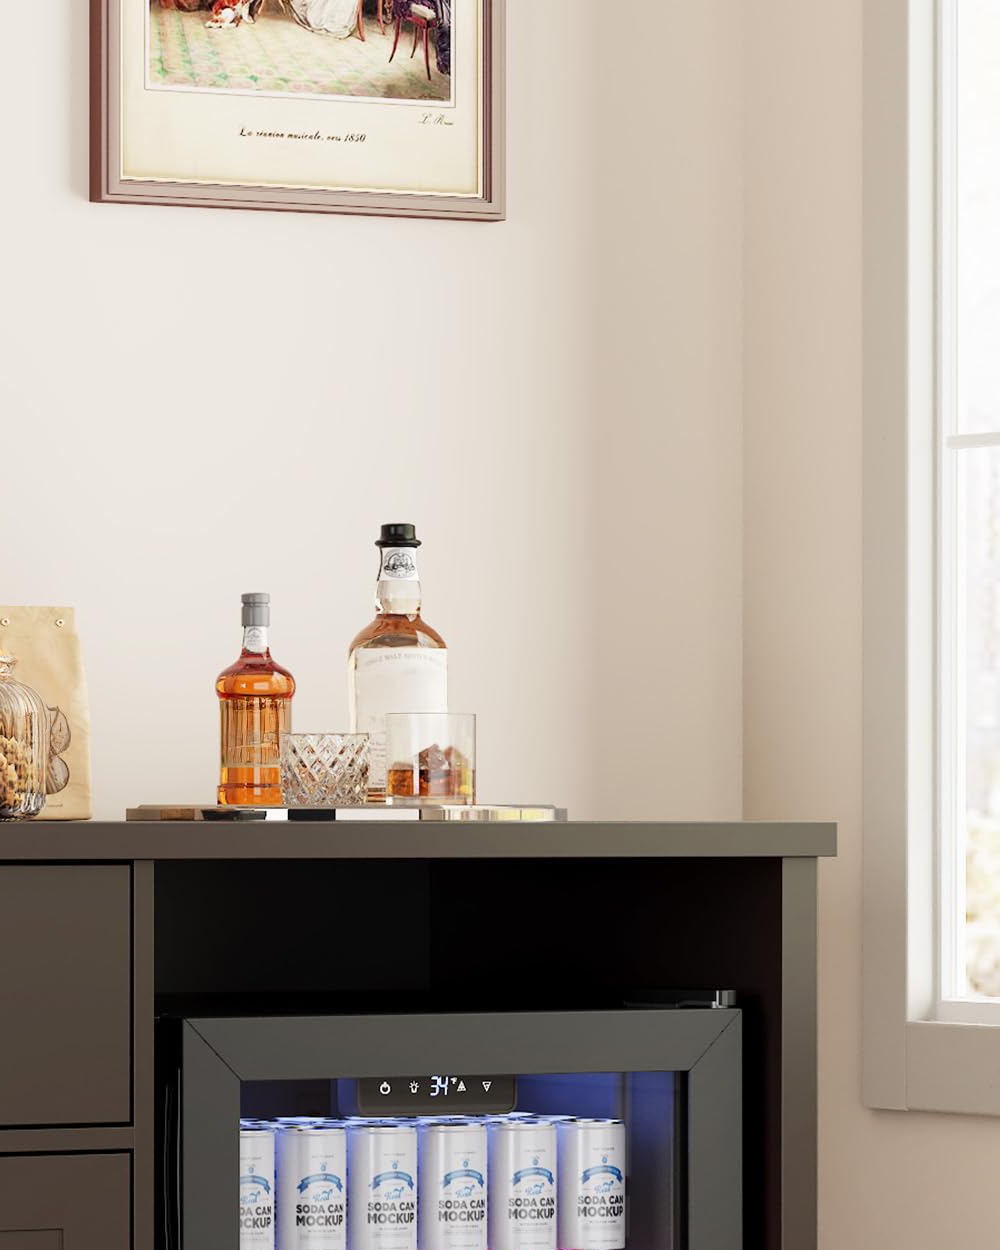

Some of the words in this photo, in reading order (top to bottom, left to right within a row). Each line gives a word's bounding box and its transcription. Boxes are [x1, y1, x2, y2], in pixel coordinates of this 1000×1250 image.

[344, 133, 367, 142] 1850
[430, 1076, 448, 1096] 34
[438, 1200, 467, 1209] SODA
[470, 1199, 485, 1209] CAN
[508, 1198, 537, 1207] SODA
[540, 1197, 555, 1207] CAN
[577, 1195, 607, 1205] SODA
[609, 1195, 624, 1205] CAN
[240, 1206, 253, 1216] DA
[255, 1205, 272, 1215] CAN
[296, 1204, 325, 1214] SODA
[328, 1204, 344, 1214] CAN
[367, 1202, 397, 1211] SODA
[399, 1202, 415, 1211] CAN
[577, 1206, 624, 1217] MOCKUP
[367, 1212, 415, 1224] MOCKUP
[438, 1210, 485, 1222] MOCKUP
[508, 1208, 555, 1219] MOCKUP
[240, 1217, 272, 1229] CKUP
[296, 1215, 343, 1226] MOCKUP
